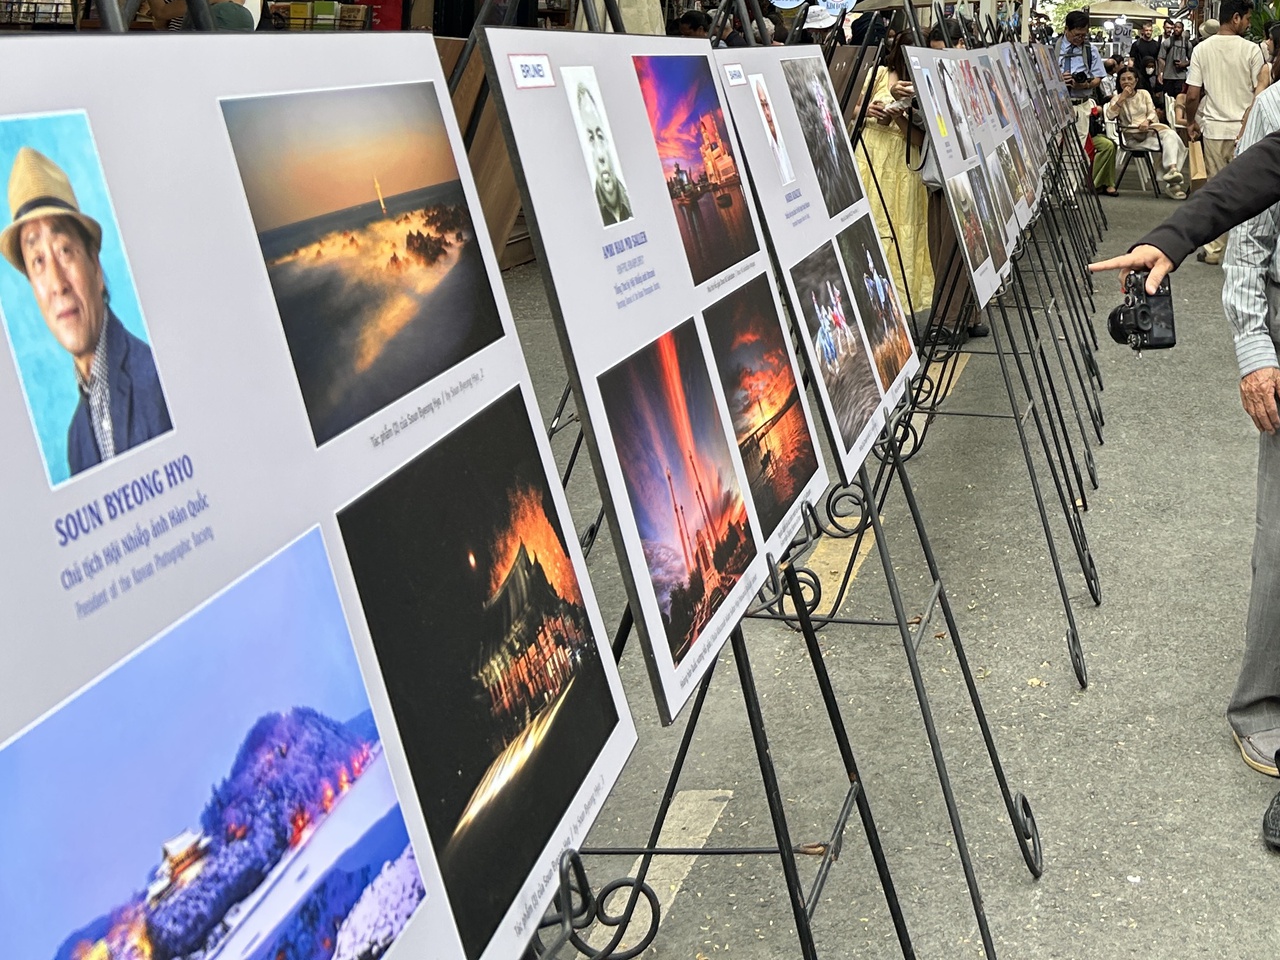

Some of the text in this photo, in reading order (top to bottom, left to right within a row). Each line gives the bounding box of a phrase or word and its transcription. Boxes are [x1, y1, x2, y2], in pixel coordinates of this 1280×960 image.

[54, 454, 194, 547] SOUN BYEONG HYO
